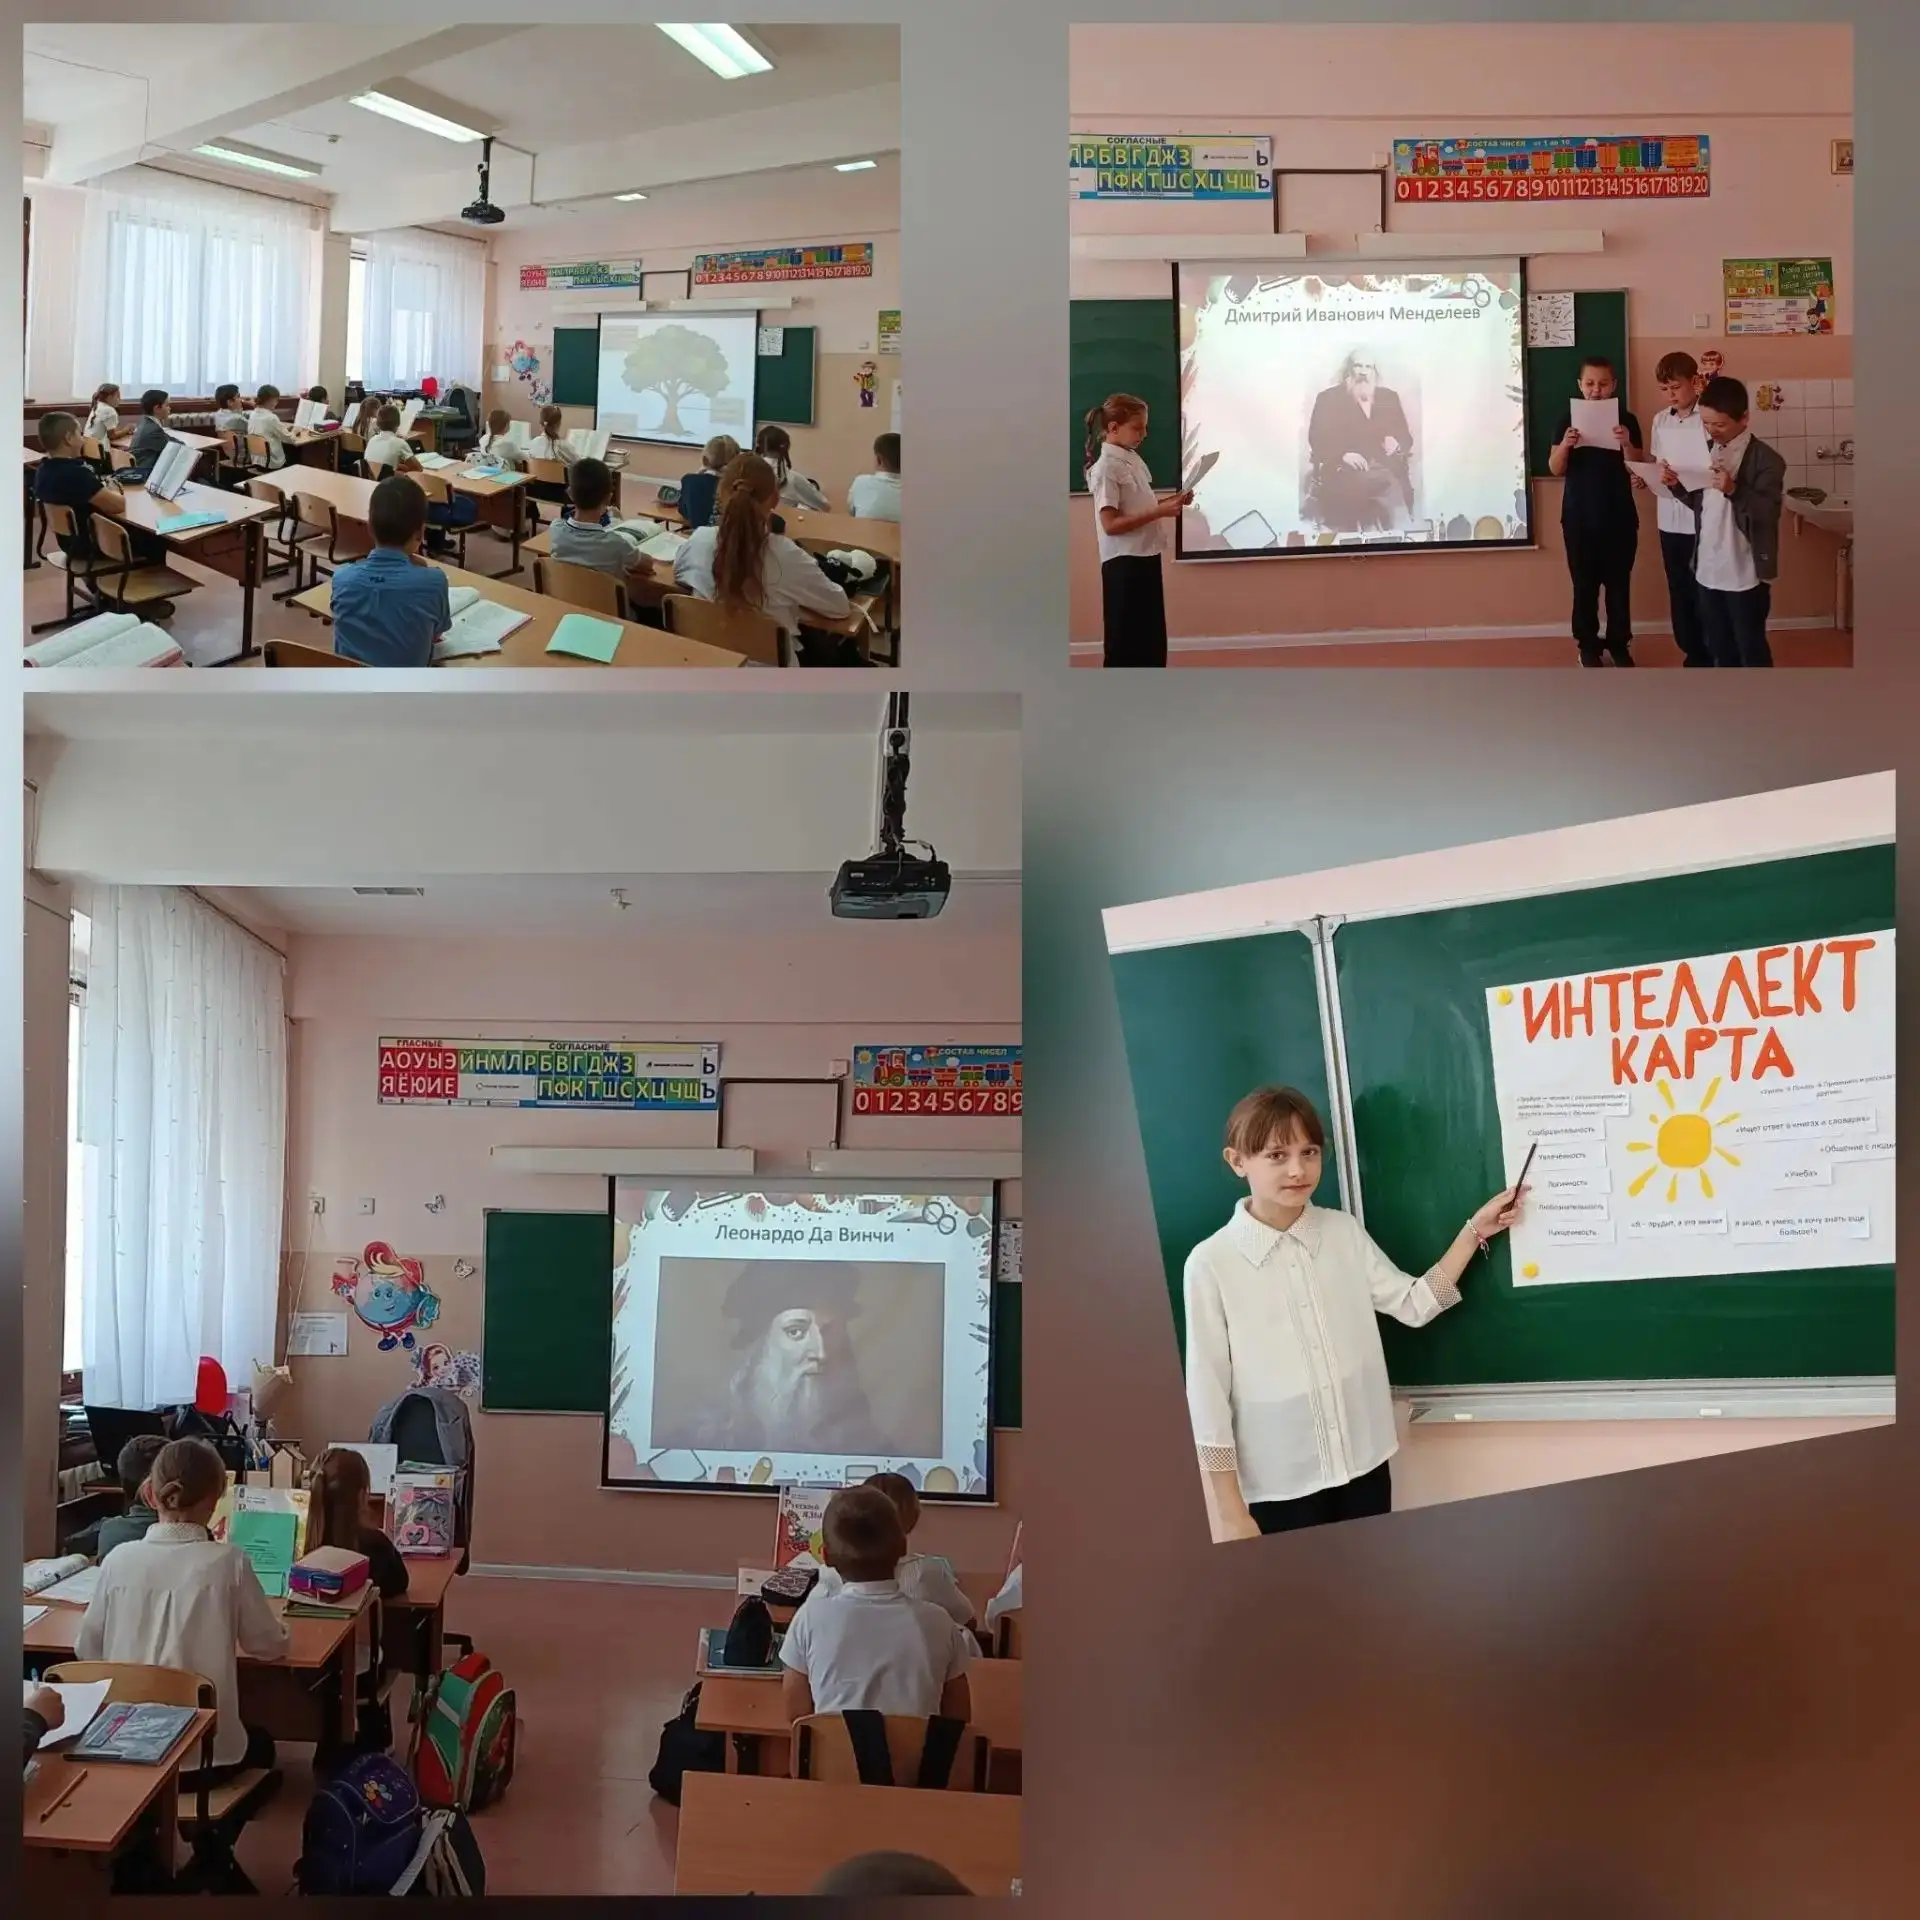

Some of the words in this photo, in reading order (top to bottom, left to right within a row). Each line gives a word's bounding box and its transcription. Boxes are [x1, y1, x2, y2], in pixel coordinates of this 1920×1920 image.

[1107, 136, 1167, 145] СОГЛАСНЫЕ
[1225, 307, 1302, 326] Дмитрий
[1306, 307, 1385, 323] Иванович
[1389, 306, 1481, 324] Менделеев
[1522, 938, 1877, 1044] ИНТЕЛЛЕКТ
[397, 1040, 443, 1048] ГЛАСНЫЕ
[549, 1042, 610, 1051] СОГЛАСНЫЕ
[938, 1048, 975, 1056] СОСТАВ
[977, 1048, 1008, 1056] ЧИСЕЛ
[1611, 1026, 1796, 1086] КАРТА
[856, 1092, 869, 1112] 0
[876, 1092, 885, 1112] 1
[890, 1092, 904, 1112] 2
[907, 1092, 921, 1112] 3
[924, 1092, 938, 1112] 4
[942, 1092, 955, 1112] 5
[958, 1092, 973, 1112] 6
[976, 1092, 990, 1112] 7
[993, 1092, 1007, 1112] 8
[1011, 1092, 1022, 1112] 9
[715, 1224, 805, 1245] Леонардо
[808, 1226, 833, 1245] Да
[839, 1226, 895, 1243] Винчи
